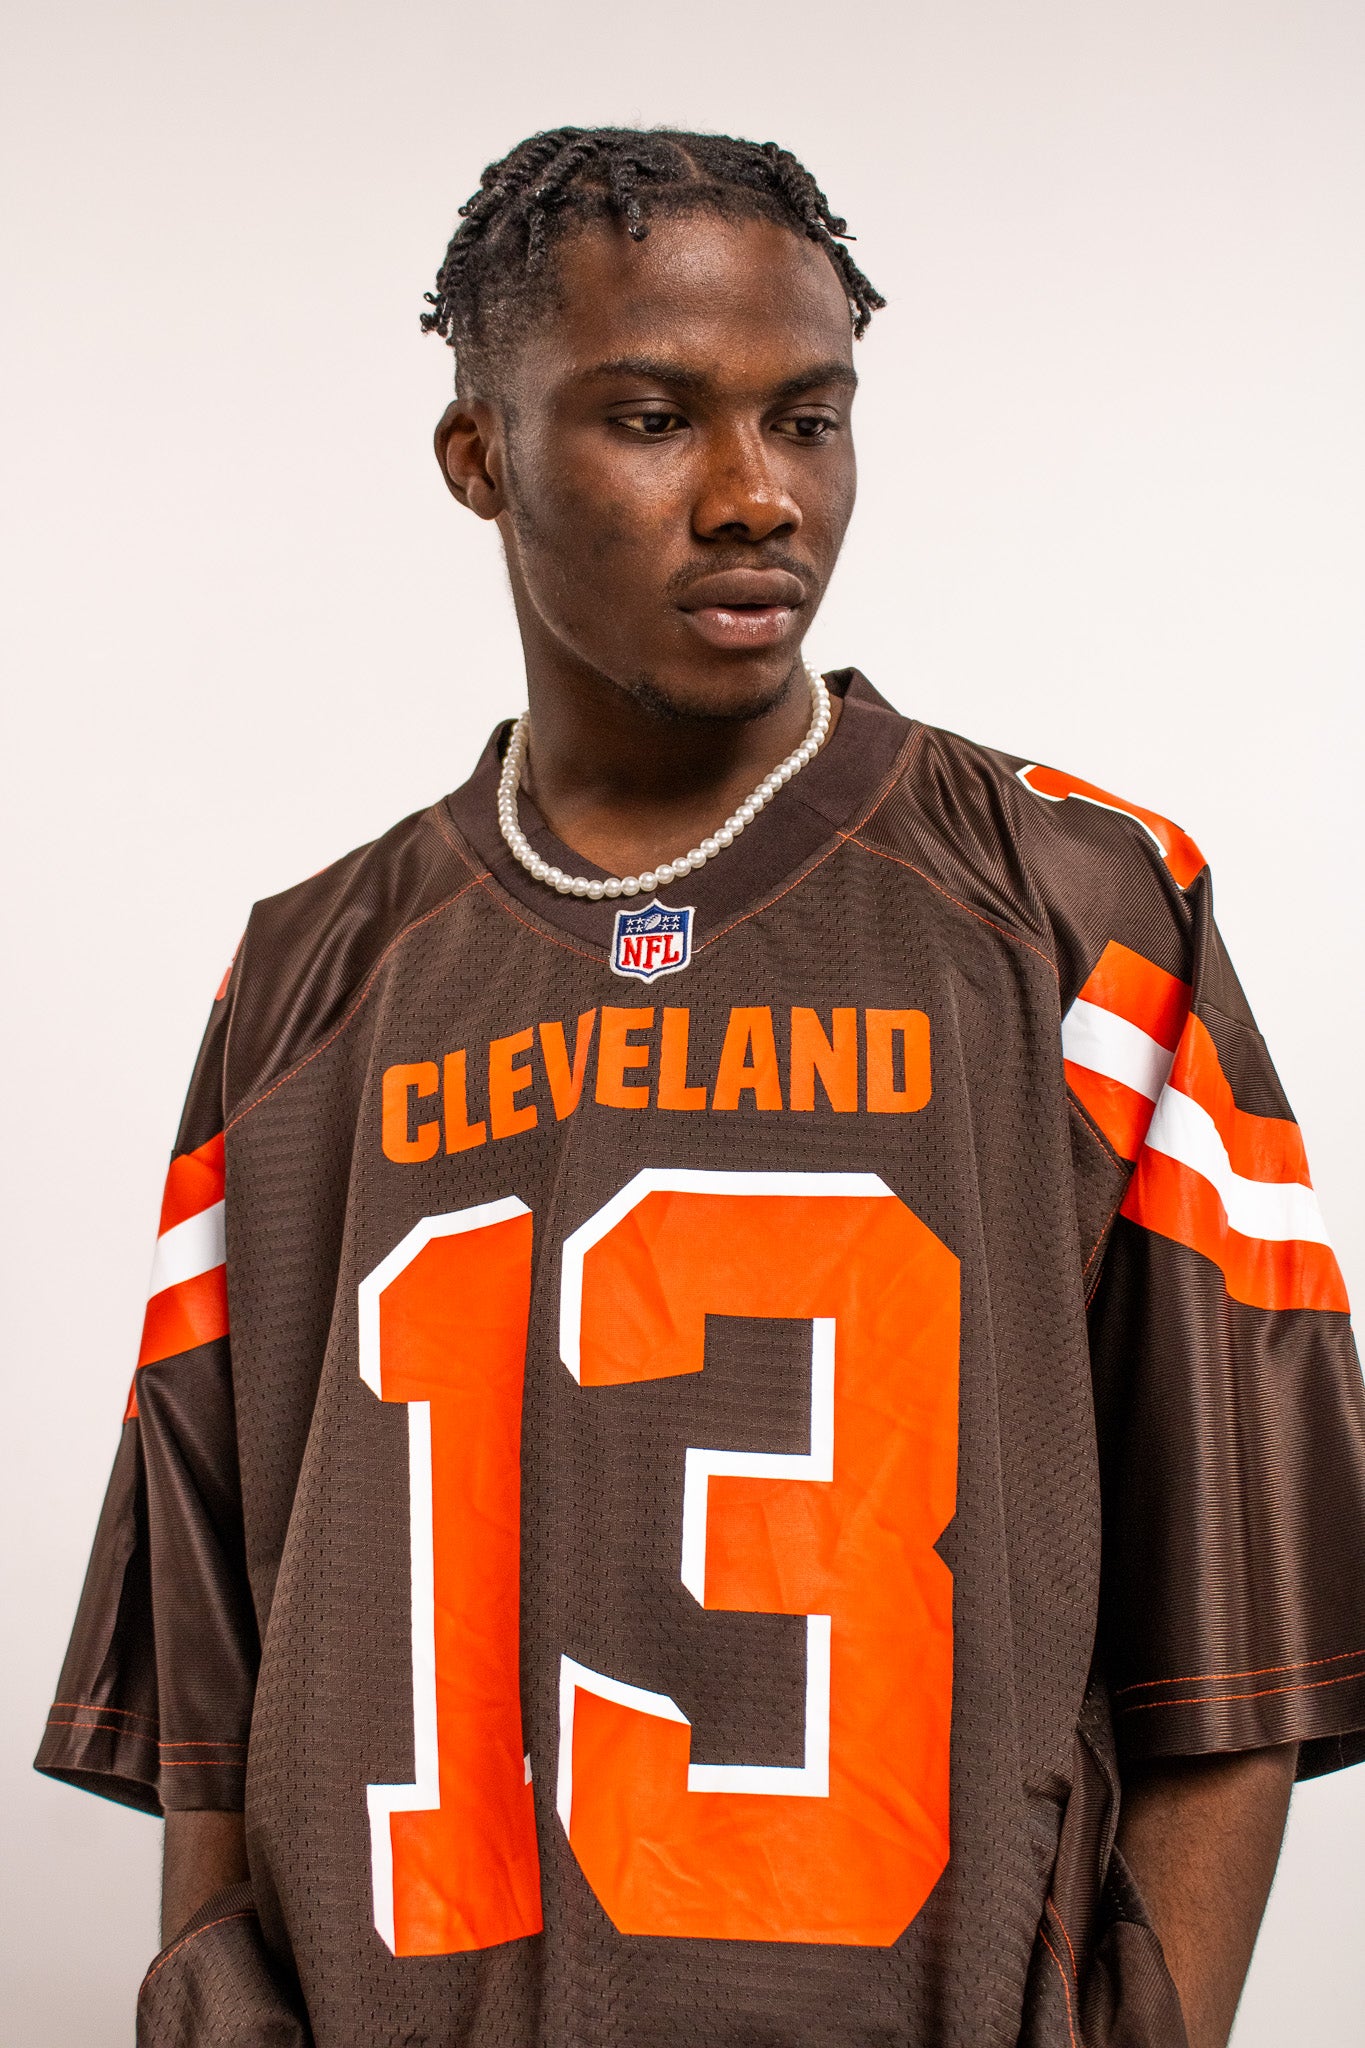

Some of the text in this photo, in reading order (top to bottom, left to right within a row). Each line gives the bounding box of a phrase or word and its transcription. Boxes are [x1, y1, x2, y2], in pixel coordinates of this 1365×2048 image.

[621, 934, 680, 969] NFL
[381, 1005, 933, 1164] CLEVELAND
[358, 1168, 961, 1958] 13
